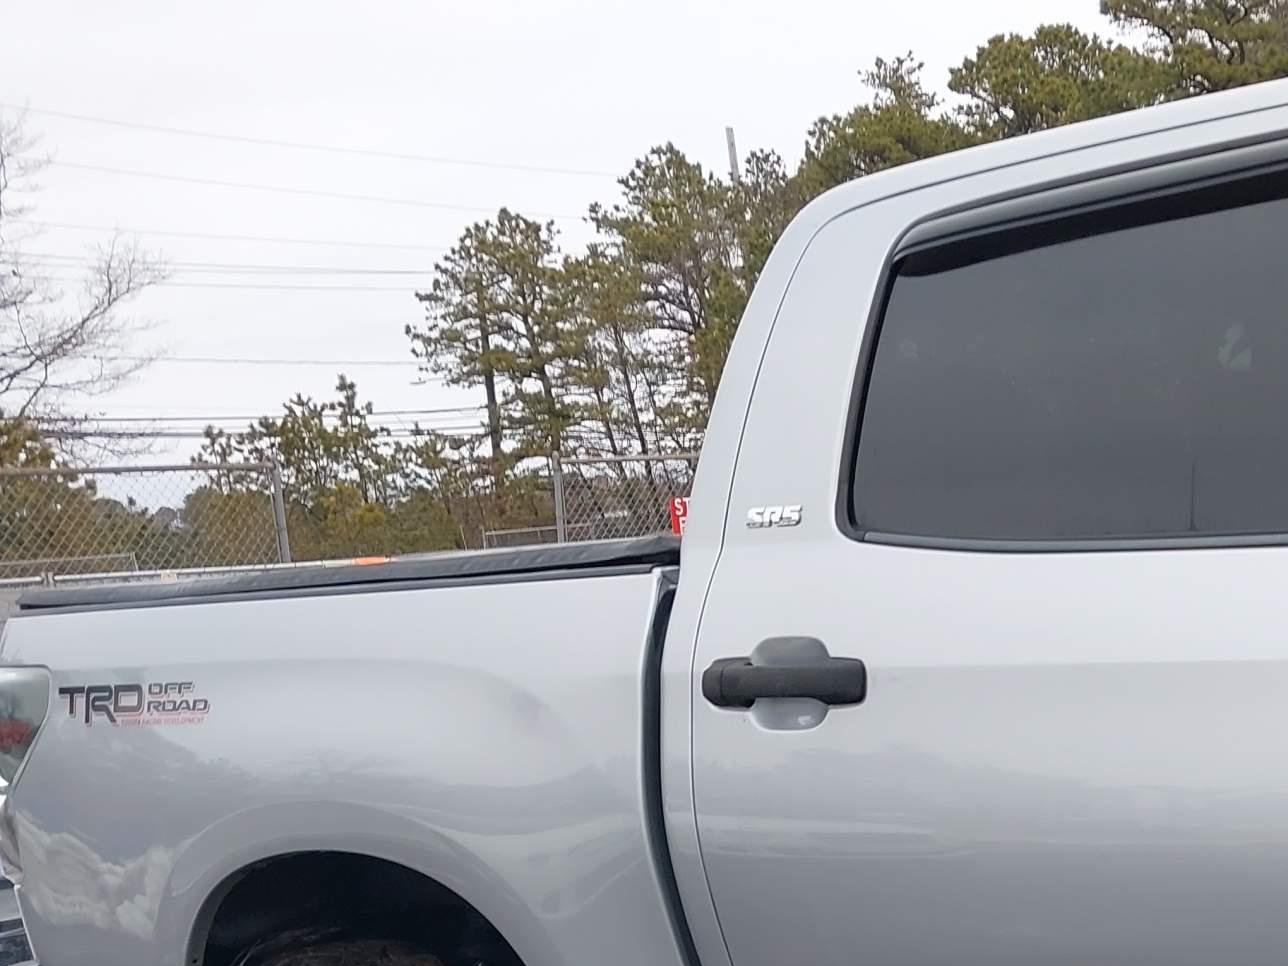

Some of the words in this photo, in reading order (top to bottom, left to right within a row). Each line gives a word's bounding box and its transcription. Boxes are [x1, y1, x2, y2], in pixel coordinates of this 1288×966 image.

[746, 505, 803, 528] SR5
[147, 682, 193, 696] OFF
[59, 684, 144, 727] TRD
[147, 699, 209, 714] ROAD
